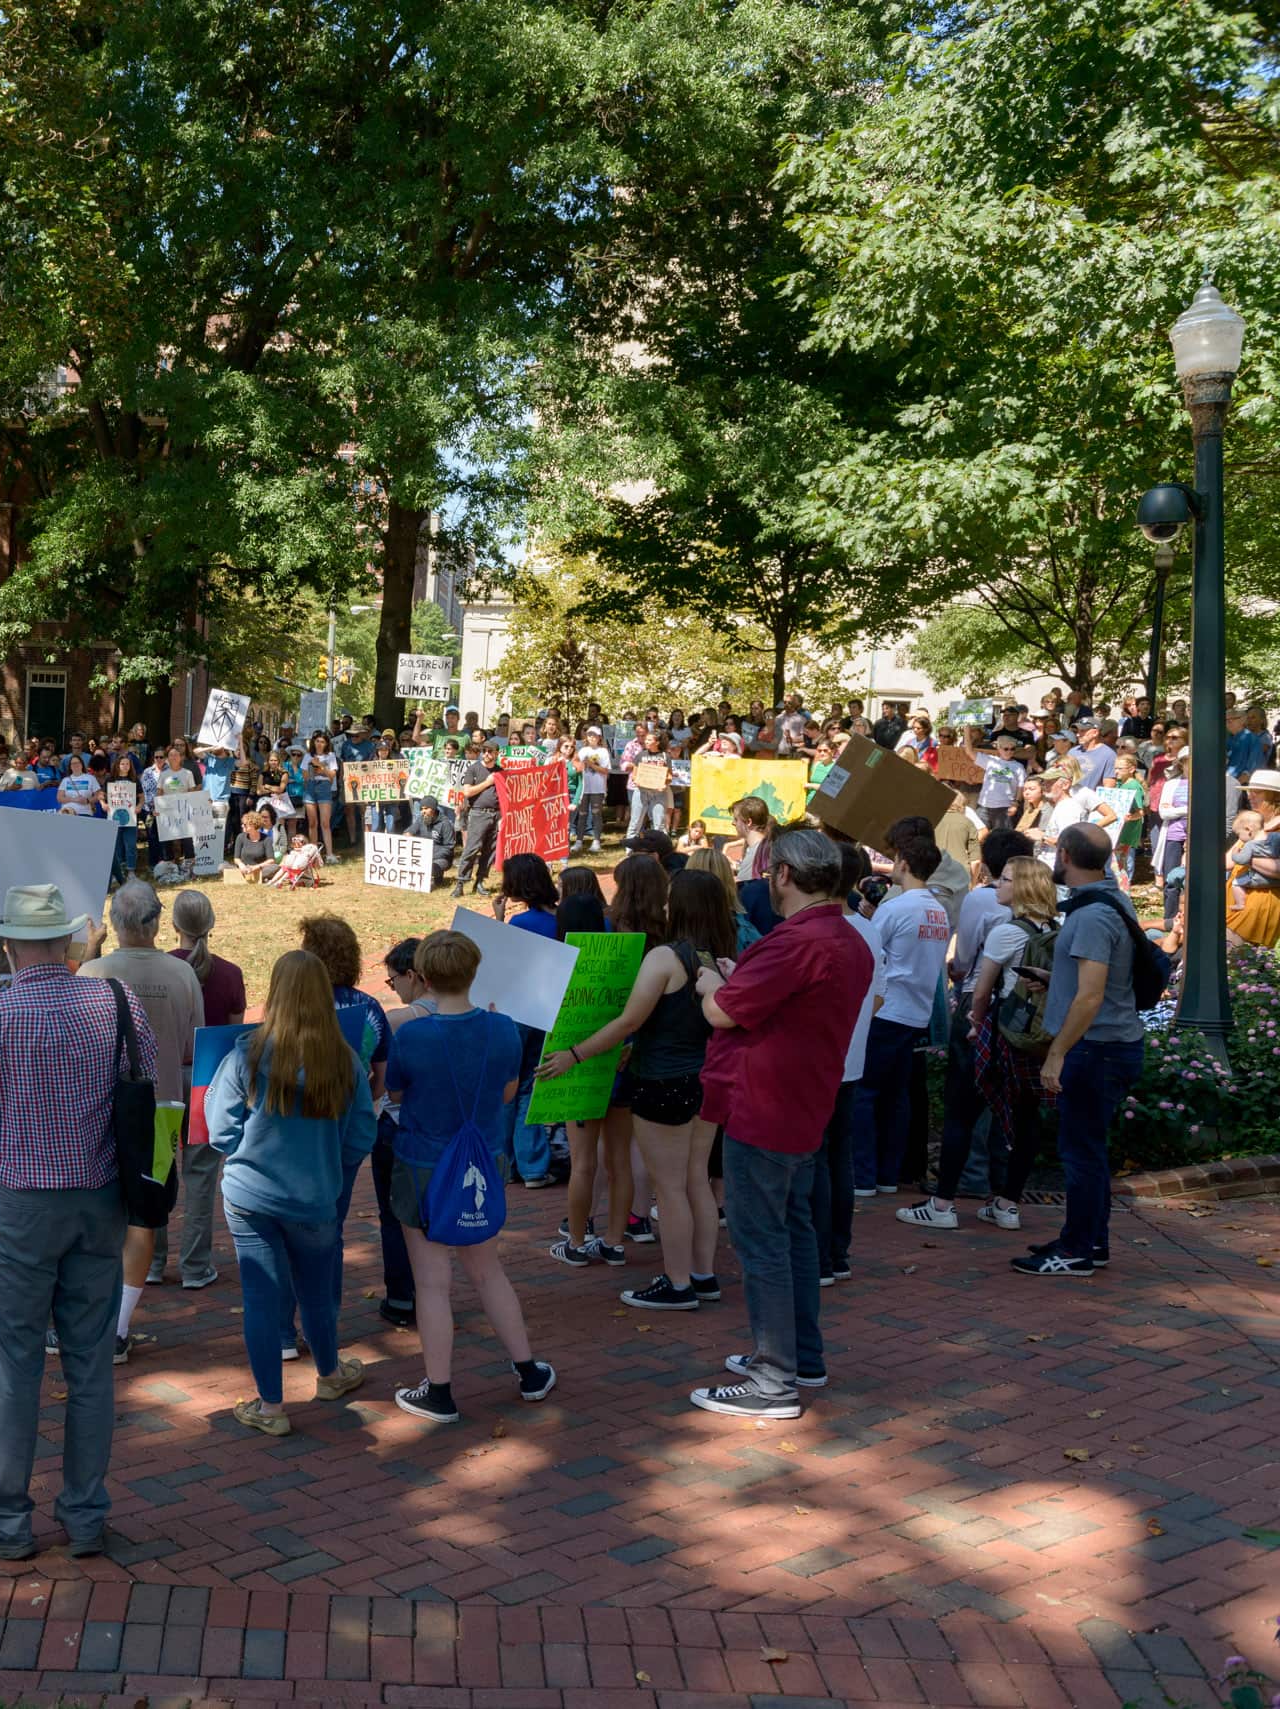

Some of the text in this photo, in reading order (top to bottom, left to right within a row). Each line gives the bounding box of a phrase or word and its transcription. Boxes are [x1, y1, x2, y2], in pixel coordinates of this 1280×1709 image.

[399, 658, 451, 670] SKOLSTREJK
[396, 684, 449, 698] KLIMATET
[347, 763, 359, 771] YOU
[396, 760, 408, 769] THE
[361, 773, 396, 784] FOSSILS
[505, 764, 561, 802] STUDENTS 4
[361, 788, 397, 800] FUEL
[505, 804, 536, 838] CLIMATE
[550, 819, 558, 830] AT
[372, 835, 422, 858] LIFE
[504, 831, 537, 859] ACTION
[545, 829, 566, 849] VCU
[372, 854, 421, 867] OVER
[369, 863, 425, 889] PROFIT
[925, 909, 947, 925] VENUE
[579, 935, 629, 958] ANIMAL
[457, 1219, 488, 1227] Foundation
